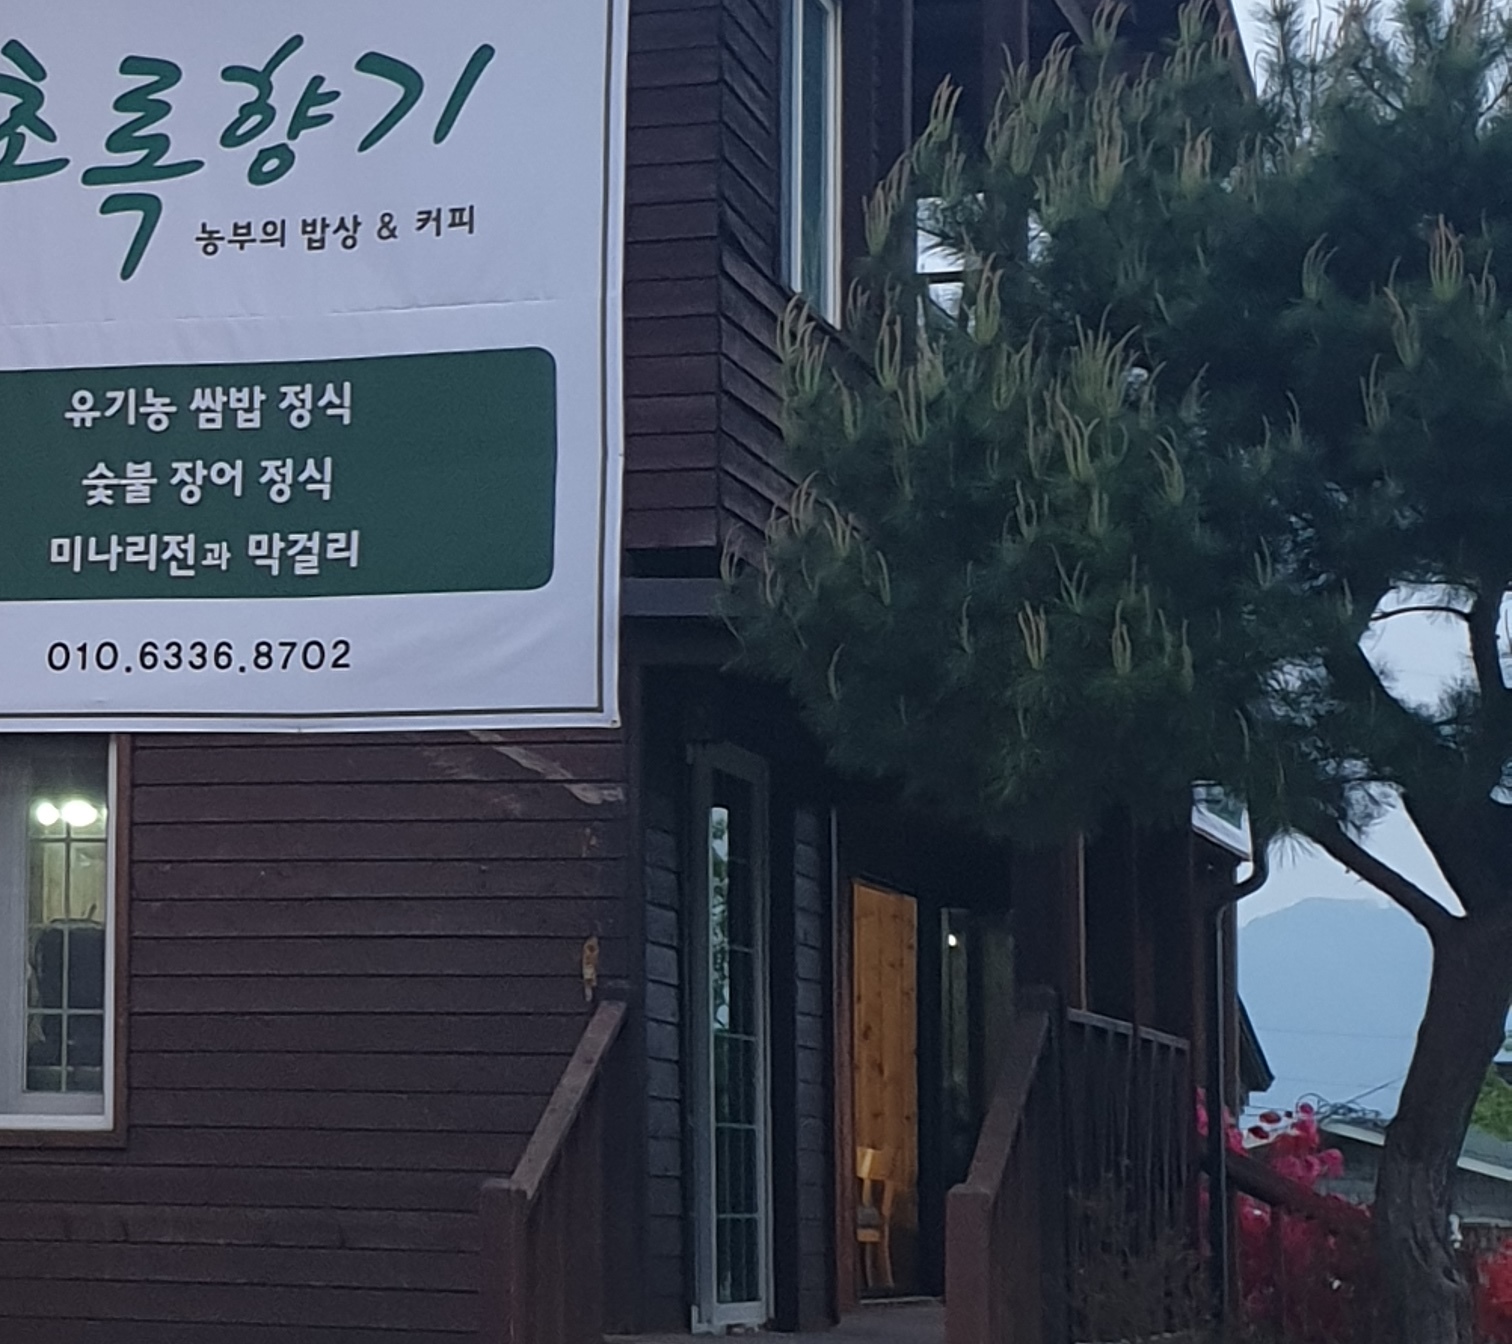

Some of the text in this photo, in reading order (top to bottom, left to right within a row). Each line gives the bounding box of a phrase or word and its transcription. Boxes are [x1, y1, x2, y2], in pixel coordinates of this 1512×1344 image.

[195, 205, 475, 257] 농부의 밥상 & 커피
[65, 382, 350, 431] 유기농 쌈밥 정식
[82, 457, 331, 505] 숯불 장어 정식
[51, 530, 359, 576] 미나리전과 막걸리
[47, 639, 351, 673] 010.6336.8702
